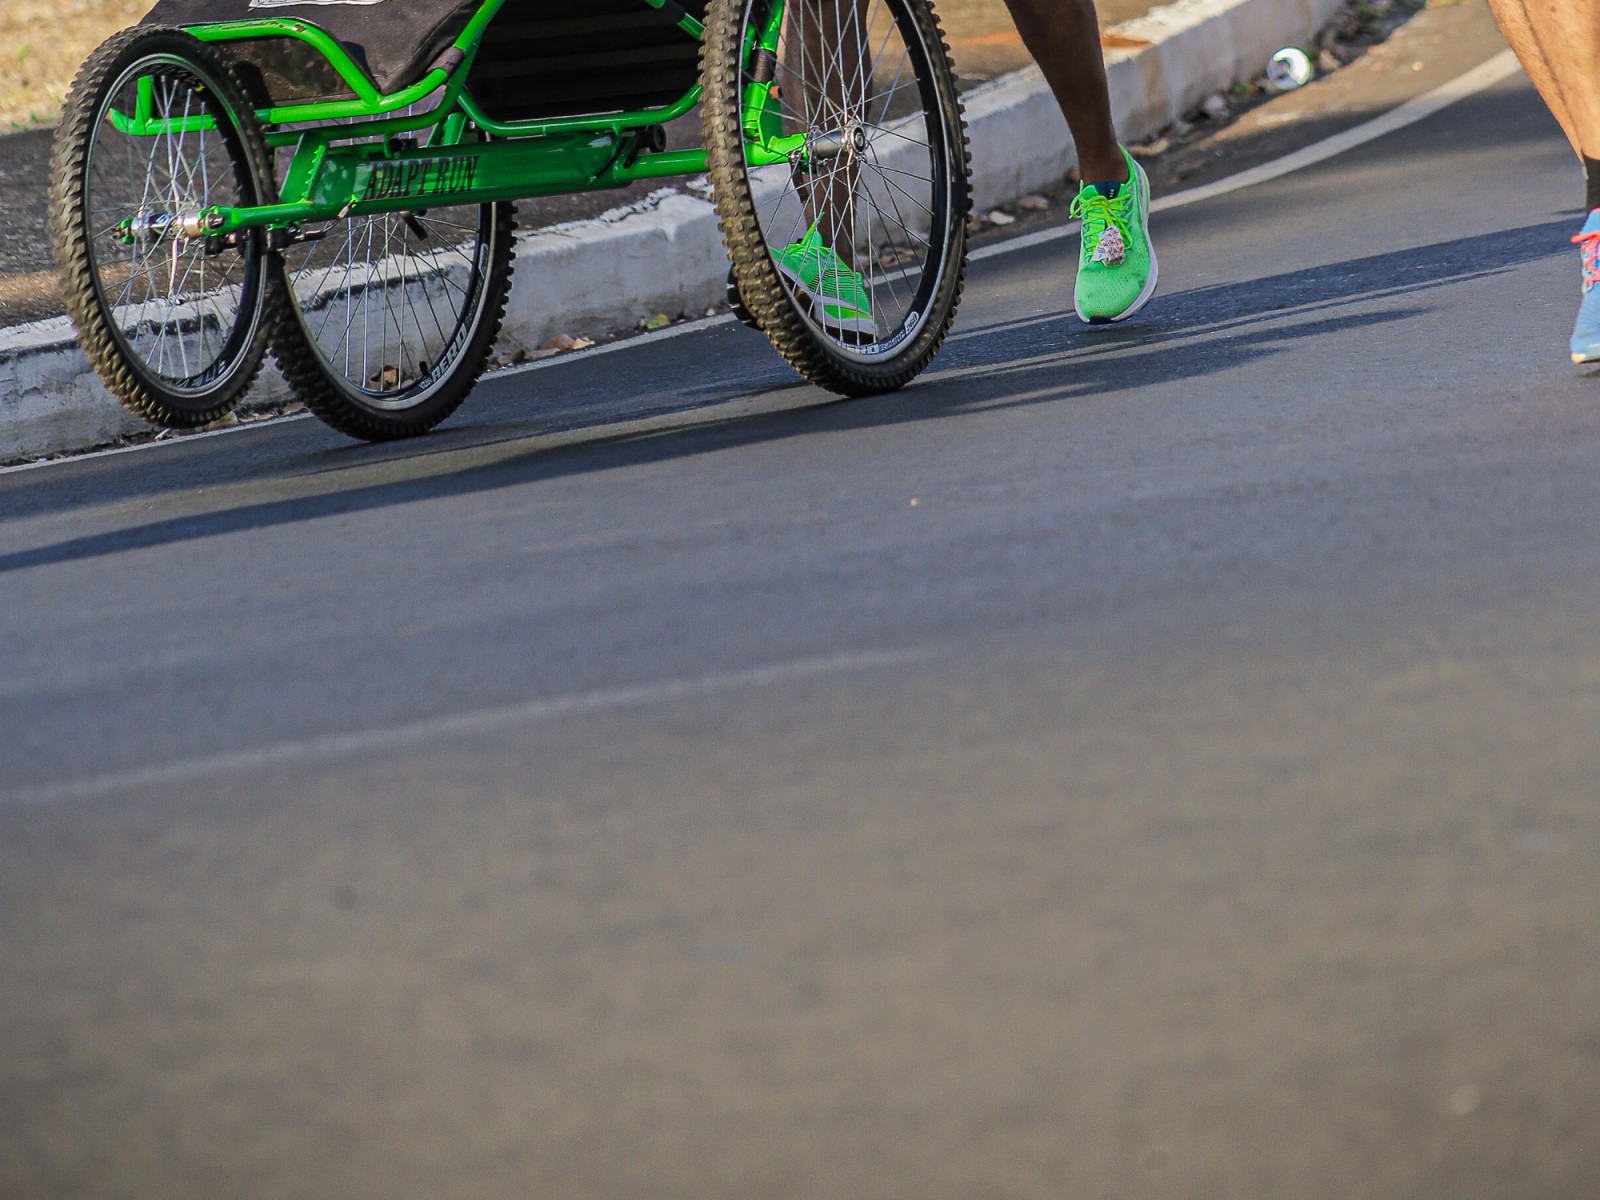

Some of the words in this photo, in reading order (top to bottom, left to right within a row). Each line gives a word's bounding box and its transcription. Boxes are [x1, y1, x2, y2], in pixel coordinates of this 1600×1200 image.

[361, 157, 433, 201] ADAPT
[432, 154, 479, 196] RUN
[431, 322, 468, 383] AERO
